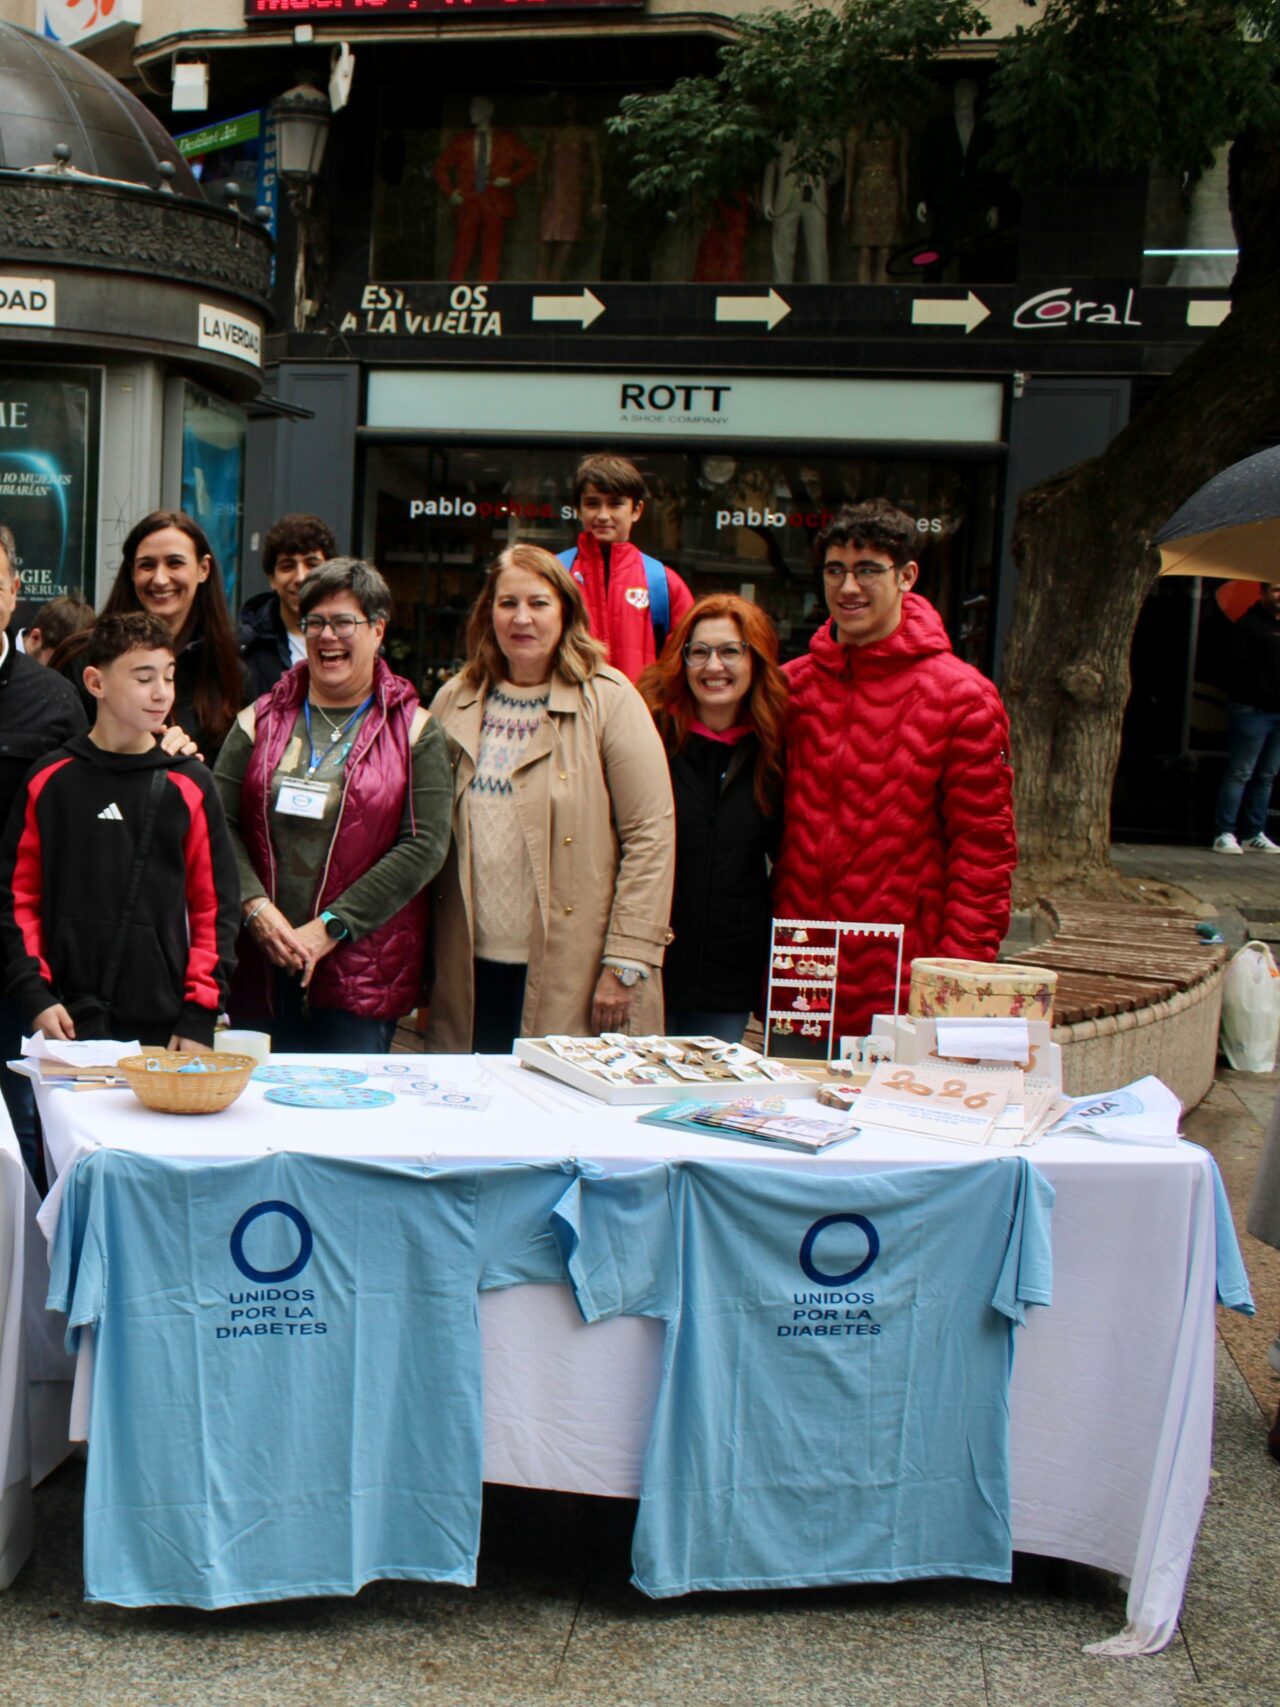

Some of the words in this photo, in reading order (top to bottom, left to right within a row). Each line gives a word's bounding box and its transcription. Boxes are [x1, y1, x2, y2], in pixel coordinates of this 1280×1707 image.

[1013, 287, 1142, 328] Coral
[203, 316, 221, 339] LA
[340, 312, 357, 332] A
[367, 311, 397, 333] LA
[405, 310, 502, 336] VUELTA
[620, 384, 732, 412] ROTT
[631, 415, 665, 423] SHOE
[669, 415, 729, 424] COMPANY
[24, 584, 68, 596] SERUM
[229, 1289, 315, 1305] UNIDOS
[794, 1292, 875, 1305] UNIDOS
[231, 1306, 276, 1321] POR
[285, 1306, 313, 1318] LA
[793, 1309, 838, 1320] POR
[846, 1309, 872, 1320] LA
[216, 1322, 328, 1339] DIABETES
[777, 1324, 881, 1336] DIABETES
